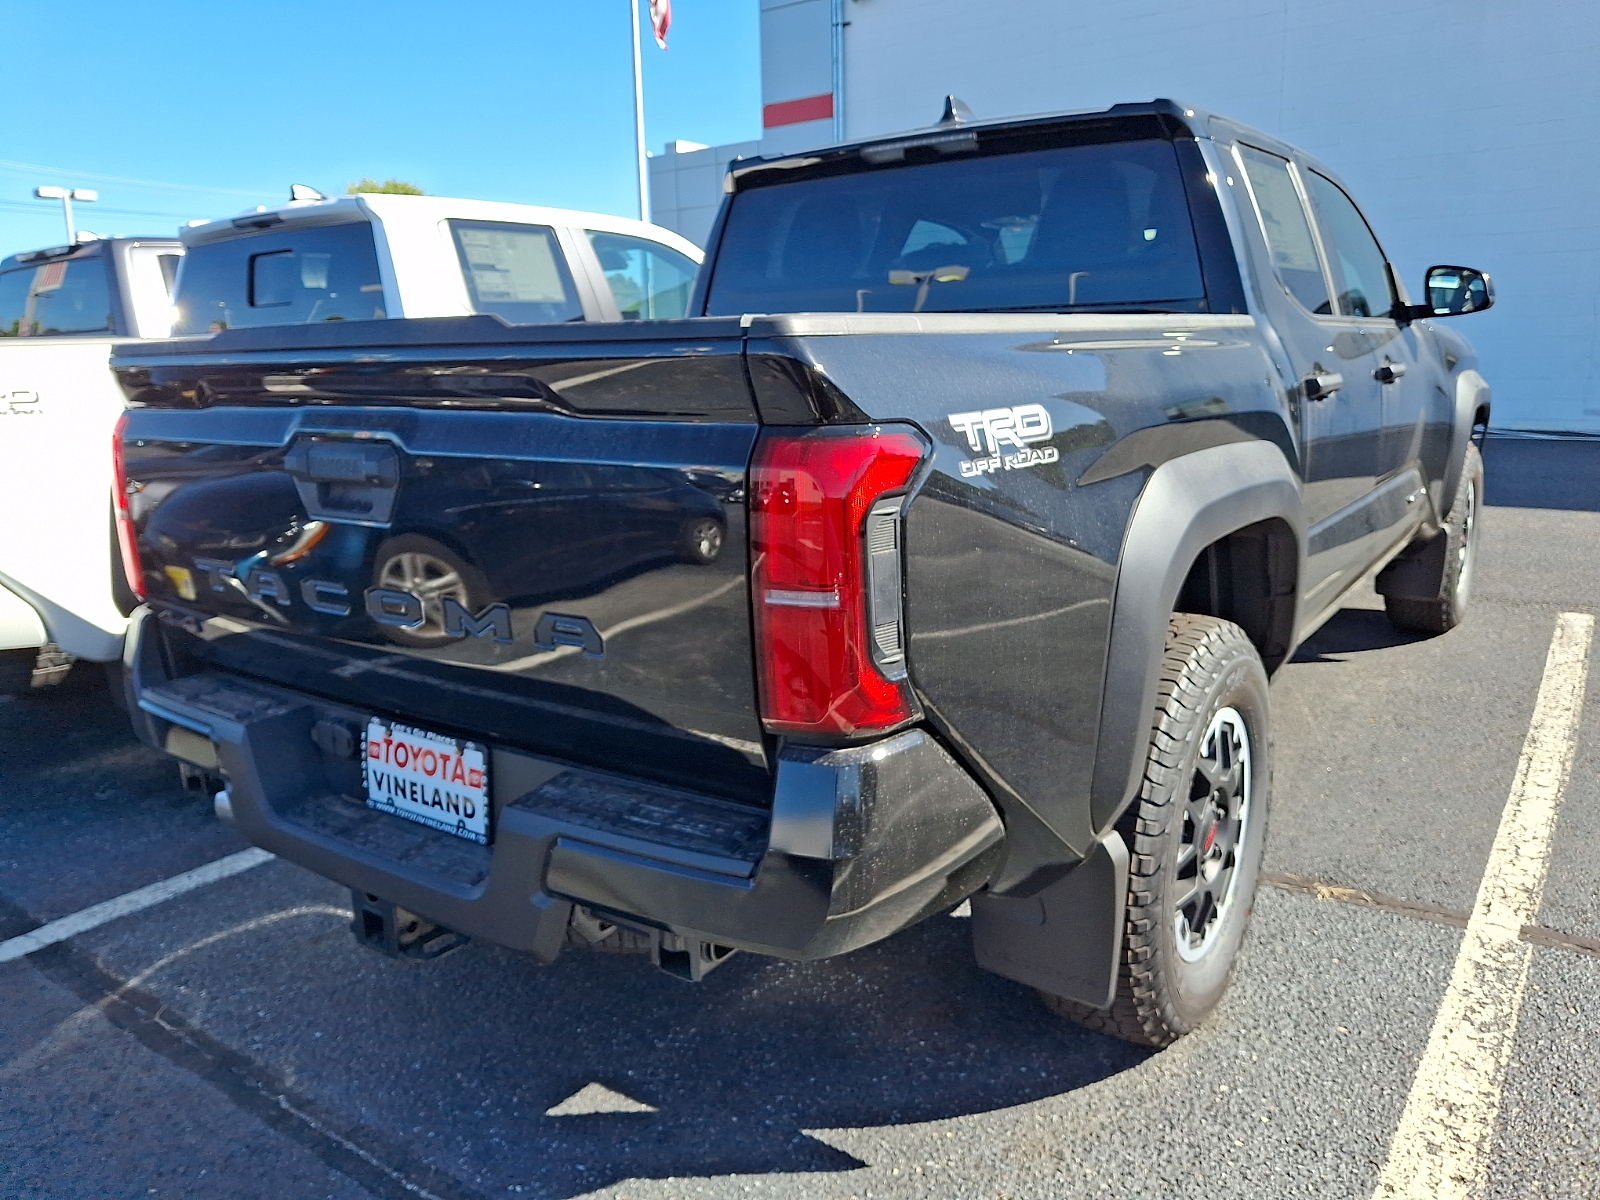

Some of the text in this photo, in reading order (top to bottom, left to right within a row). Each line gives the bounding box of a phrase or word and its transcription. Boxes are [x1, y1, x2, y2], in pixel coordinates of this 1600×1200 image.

[948, 403, 1053, 457] TRD
[958, 446, 1060, 478] OFF ROAD
[192, 556, 606, 659] TACOMA
[383, 738, 467, 786] TOYOTA
[372, 769, 476, 819] VINELAND
